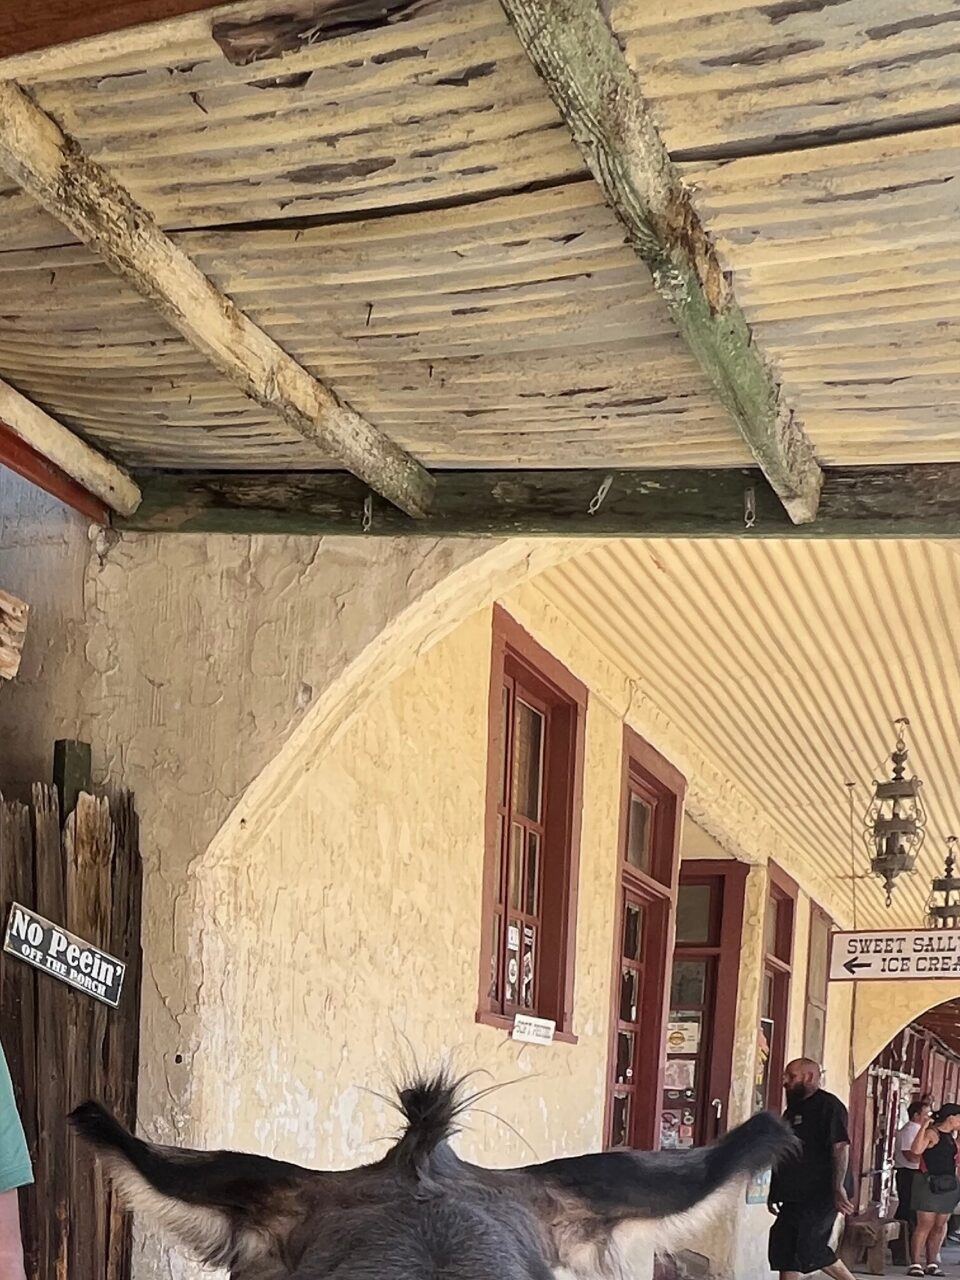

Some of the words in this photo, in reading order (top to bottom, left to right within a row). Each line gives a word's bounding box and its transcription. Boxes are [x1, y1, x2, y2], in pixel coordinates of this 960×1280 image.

[11, 909, 44, 946] No
[47, 929, 122, 987] Peein'
[846, 937, 907, 954] SWEET
[912, 936, 960, 953] SALL
[21, 943, 44, 963] OFF
[45, 955, 68, 976] THE
[69, 969, 107, 997] PORCH
[880, 957, 911, 973] ICE
